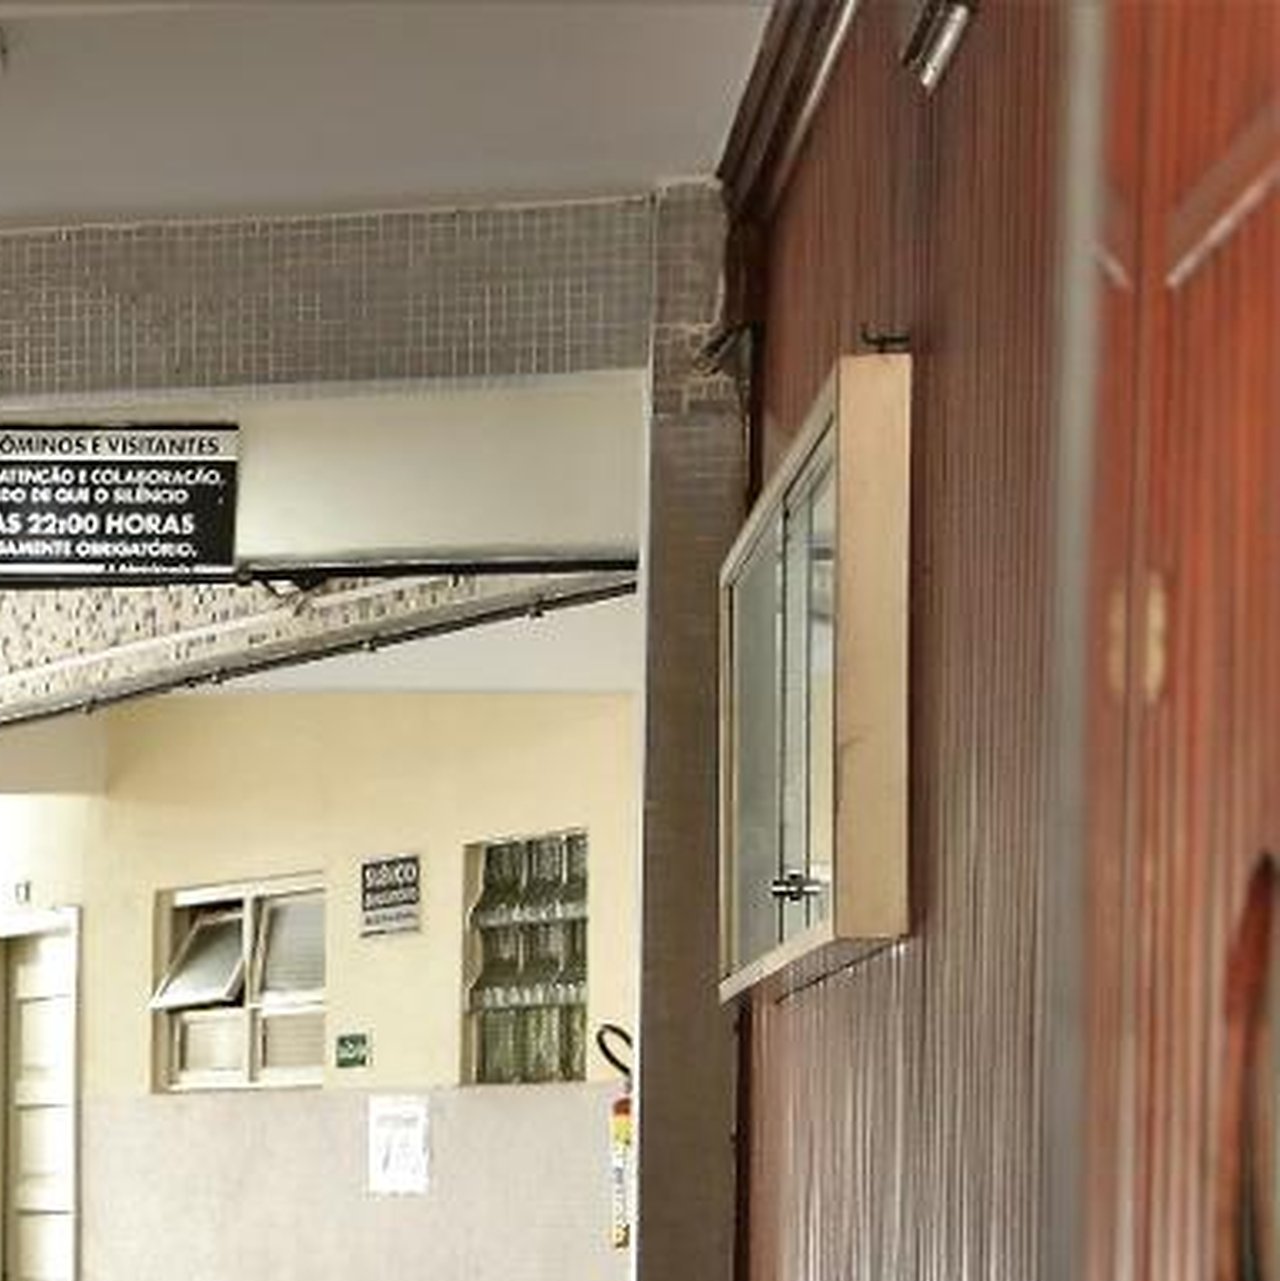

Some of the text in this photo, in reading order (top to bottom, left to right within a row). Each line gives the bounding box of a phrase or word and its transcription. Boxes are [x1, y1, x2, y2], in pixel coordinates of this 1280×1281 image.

[91, 436, 101, 454] E
[107, 436, 221, 455] VISITANTES
[31, 487, 52, 503] DE
[54, 487, 90, 503] QUE
[94, 488, 110, 504] O
[113, 483, 190, 504] SILÊNCIO
[27, 512, 99, 535] 22:00
[105, 512, 195, 535] HORAS
